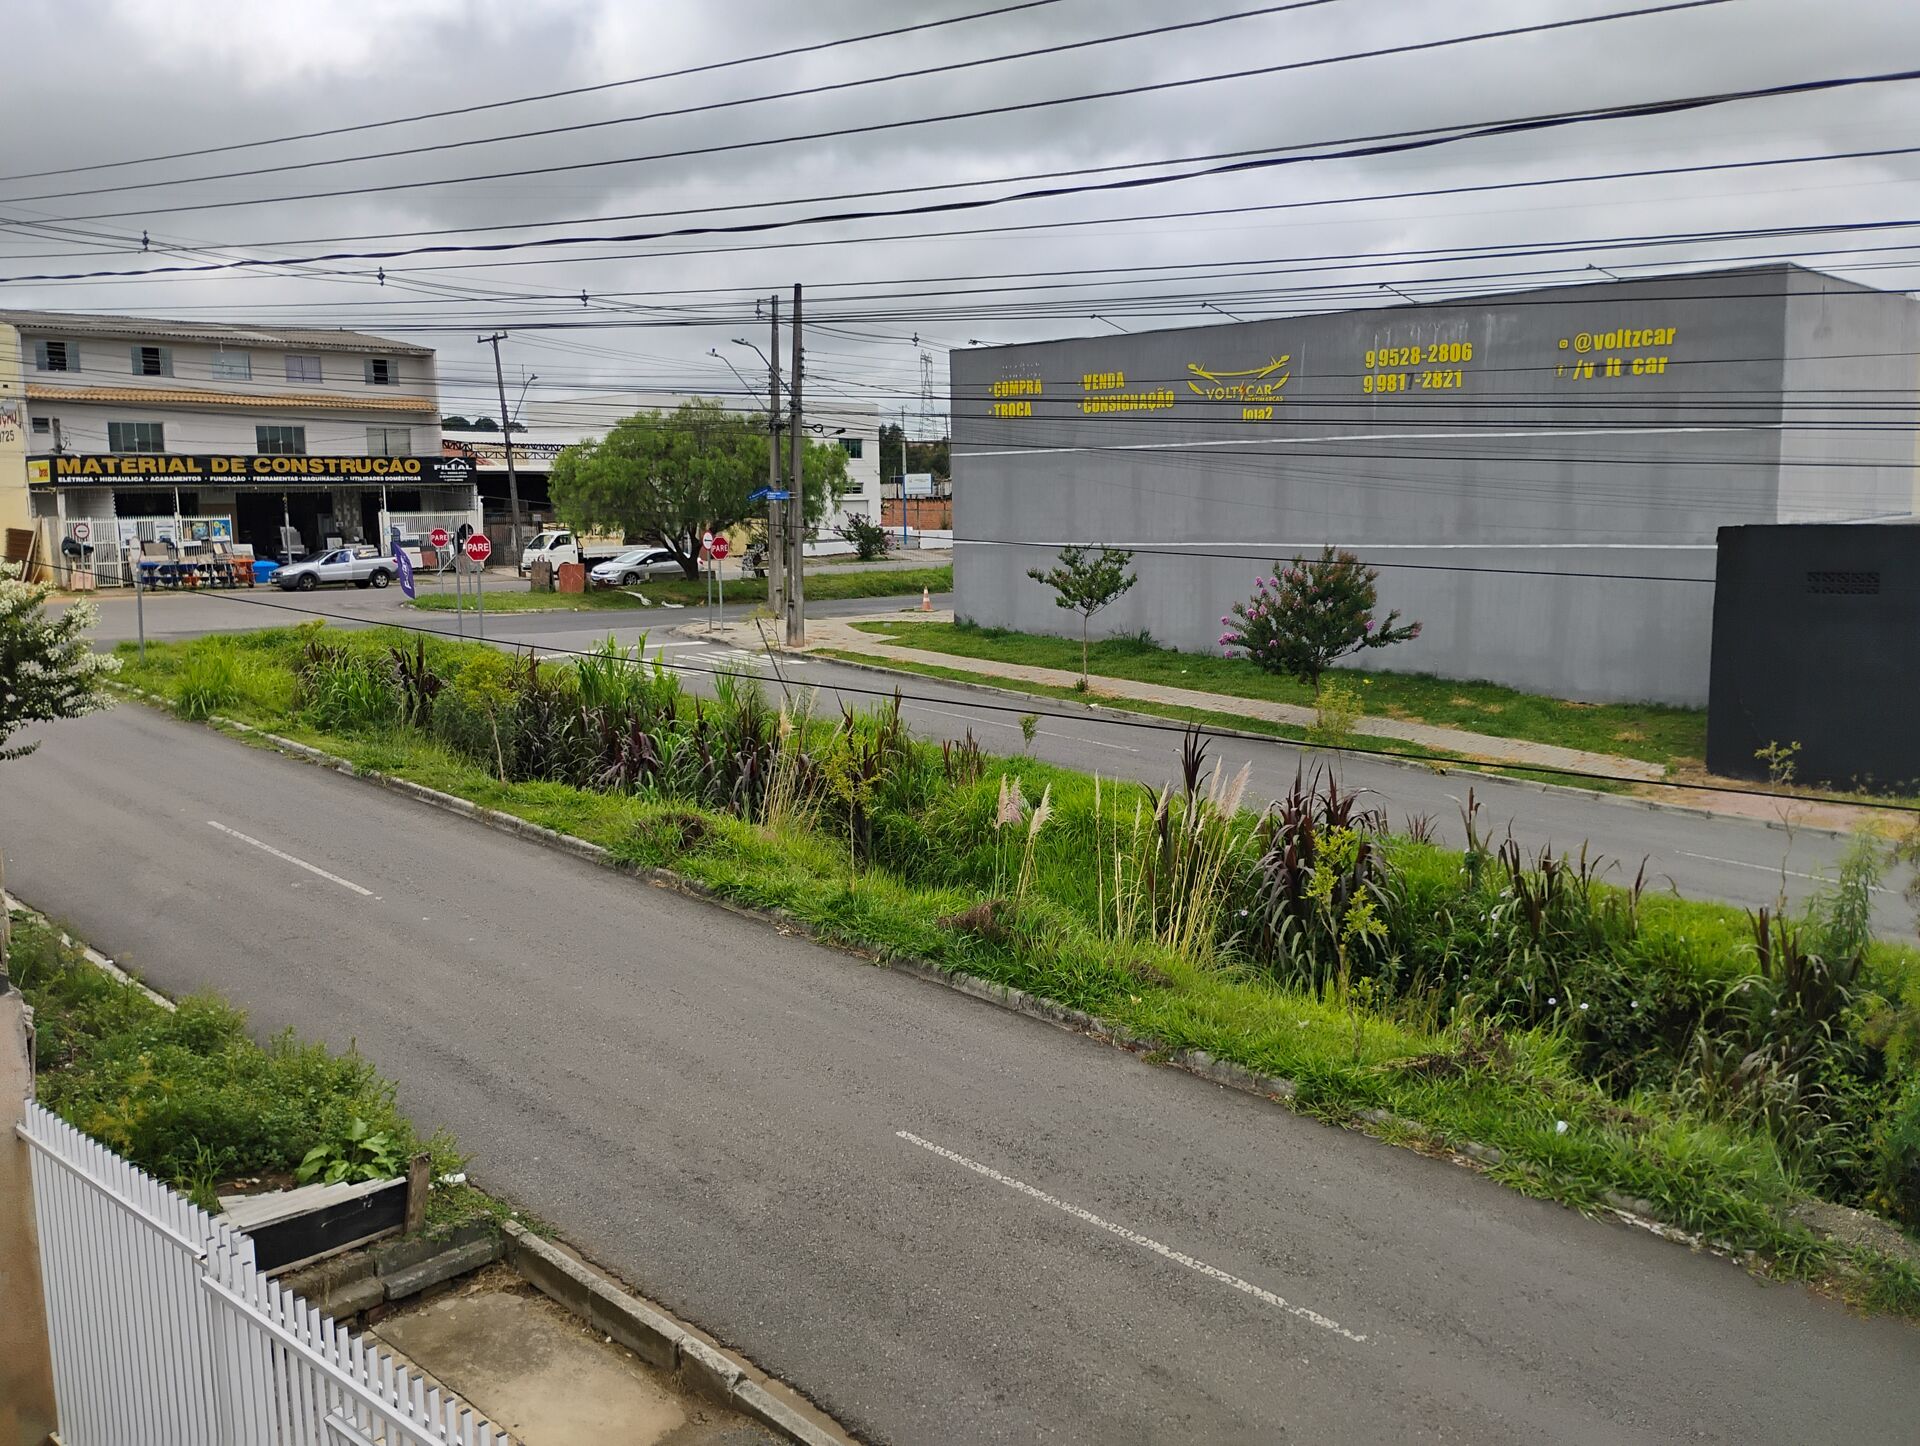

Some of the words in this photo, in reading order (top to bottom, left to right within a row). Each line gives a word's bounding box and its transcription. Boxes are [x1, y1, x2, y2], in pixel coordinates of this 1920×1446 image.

[1574, 327, 1676, 353] @voltzcar
[993, 379, 1042, 398] COMPRA
[1083, 371, 1125, 391] VENDA
[1083, 386, 1175, 413] CONSIGNAÇÃO
[993, 401, 1032, 419] TROCA
[0, 425, 15, 443] 725
[57, 457, 203, 474] MATERIAL
[210, 457, 247, 473] DE
[253, 456, 421, 475] CONSTRUÇÃO
[434, 463, 473, 471] FILIAL
[58, 475, 93, 483] ELÉTRICA
[209, 475, 246, 483] FUNDAÇÃO
[431, 534, 448, 542] PARE
[467, 543, 490, 553] PARE
[712, 544, 729, 552] PARE
